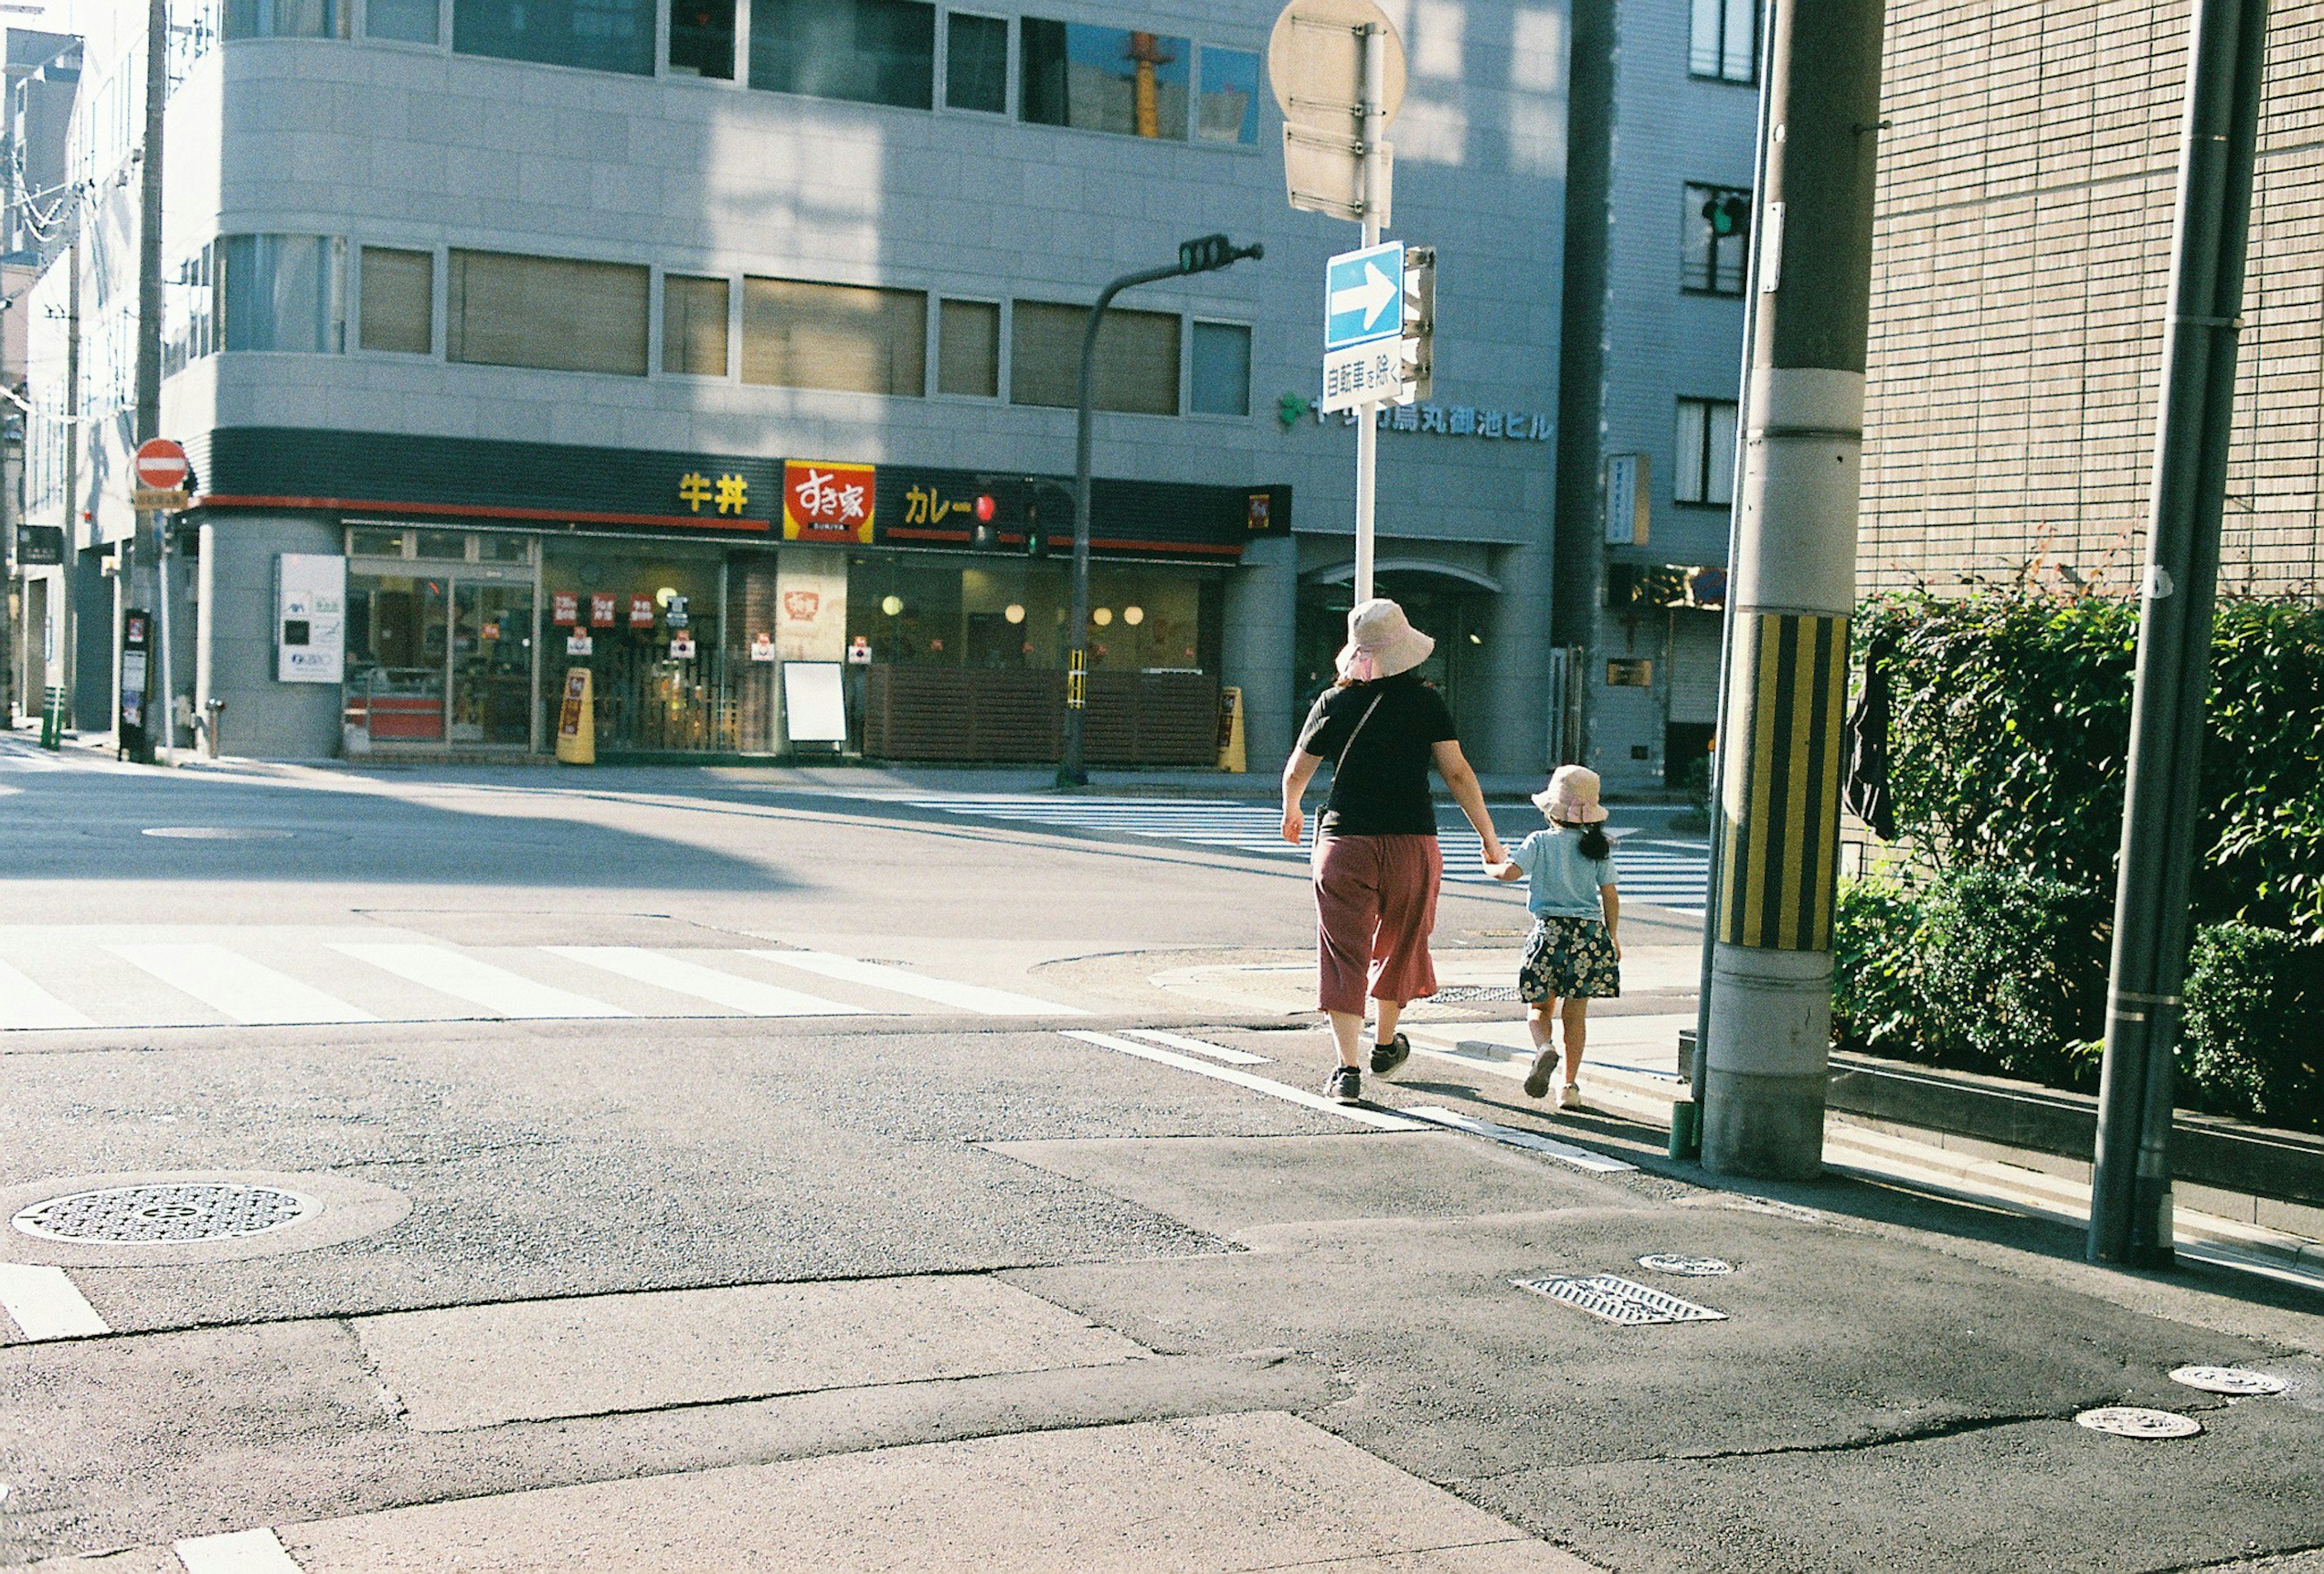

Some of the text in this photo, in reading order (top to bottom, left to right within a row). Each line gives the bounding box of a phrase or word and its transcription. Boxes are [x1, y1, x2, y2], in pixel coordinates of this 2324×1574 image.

[1328, 354, 1397, 397] 自転車を除く
[1310, 395, 1554, 440] 烏丸御池ビル
[679, 471, 748, 514] 牛丼
[795, 468, 865, 522] すき家
[905, 485, 971, 525] カレー
